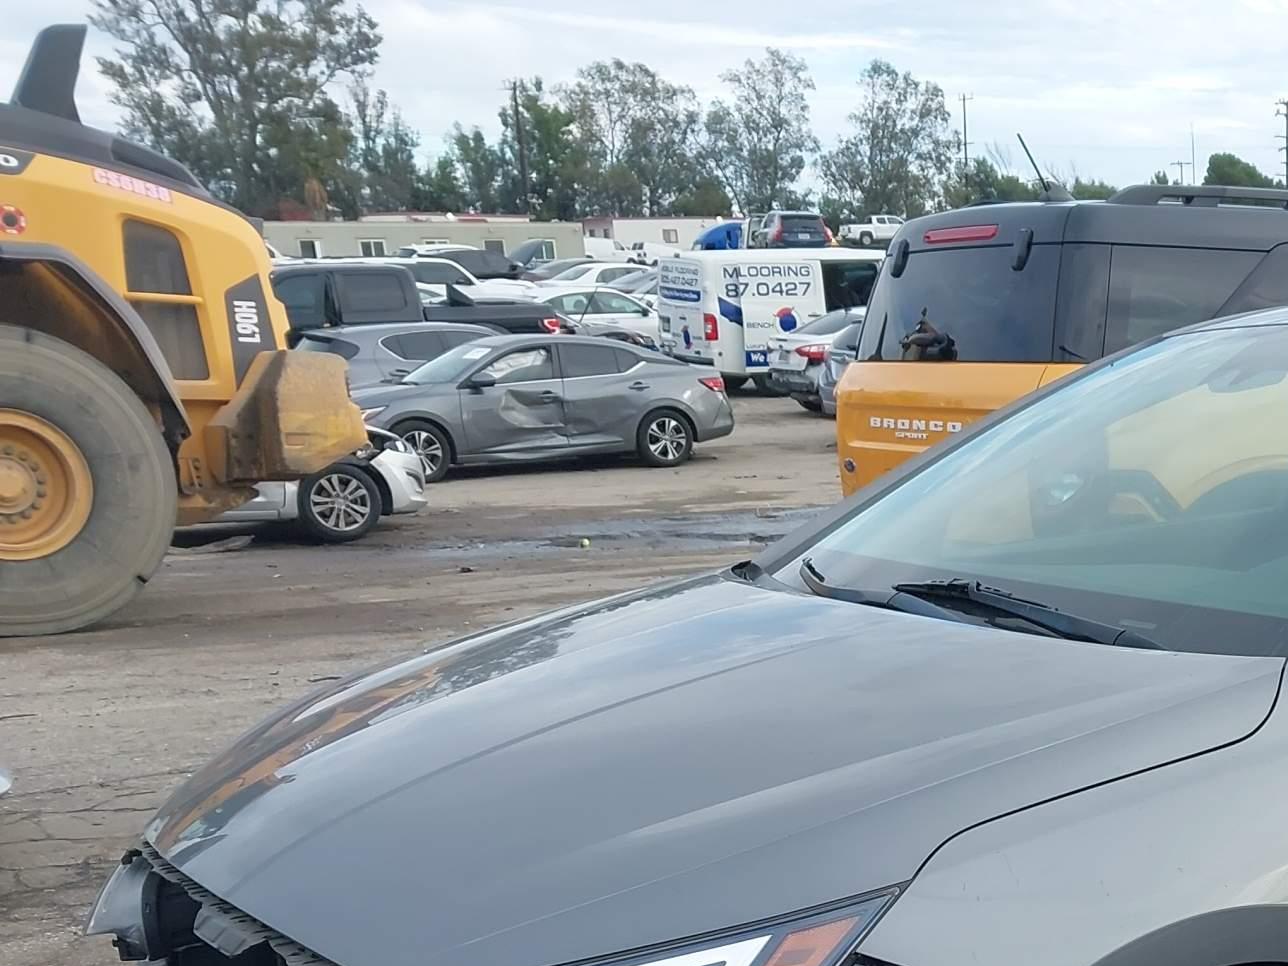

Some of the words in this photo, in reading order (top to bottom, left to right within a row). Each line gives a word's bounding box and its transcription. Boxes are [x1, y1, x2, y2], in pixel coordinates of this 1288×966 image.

[725, 282, 811, 298] 87.0427
[233, 300, 261, 344] L90H
[869, 416, 963, 433] BRONCO
[895, 431, 929, 440] SPORT
